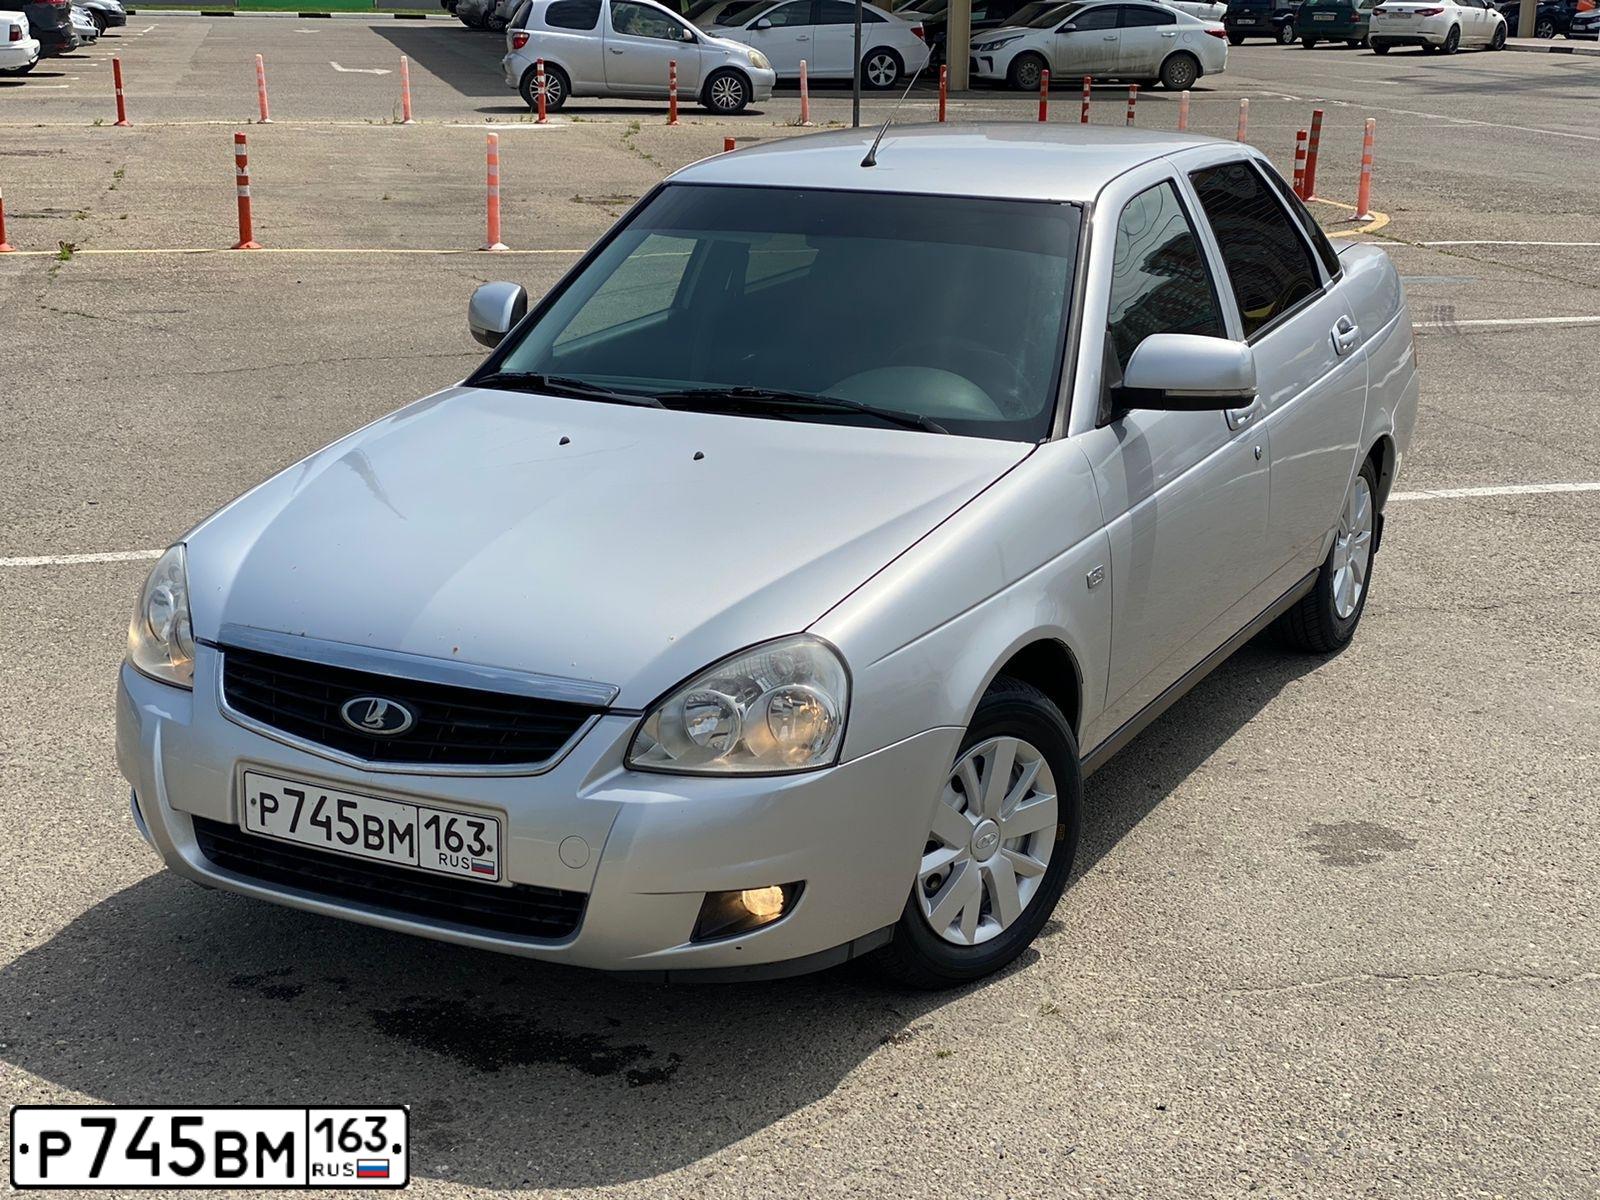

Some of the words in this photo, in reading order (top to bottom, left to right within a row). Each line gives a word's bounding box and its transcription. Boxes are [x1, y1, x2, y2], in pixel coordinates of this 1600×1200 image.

[259, 787, 415, 859] Р745ВМ
[423, 814, 486, 858] 163
[438, 852, 470, 870] RUS
